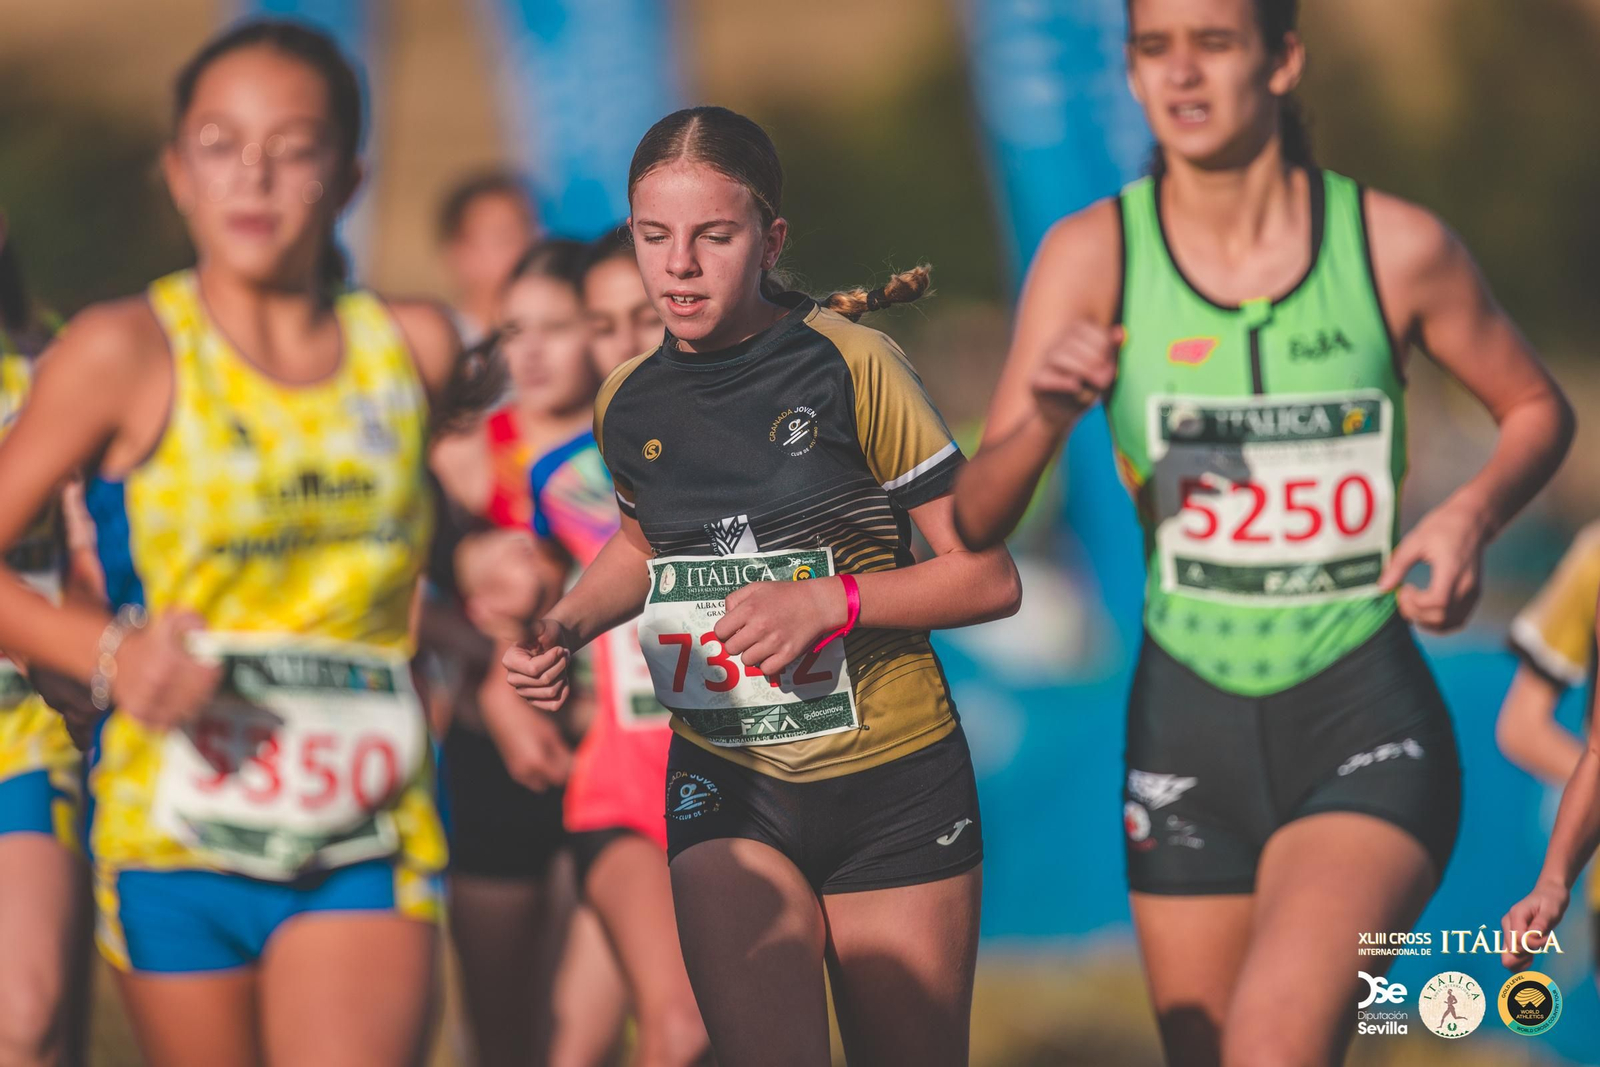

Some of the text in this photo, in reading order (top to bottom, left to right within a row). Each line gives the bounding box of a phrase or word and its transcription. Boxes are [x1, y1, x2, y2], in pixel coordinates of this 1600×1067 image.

[769, 406, 817, 442] GRANADA JOVEN
[1178, 474, 1376, 544] 5250
[687, 561, 777, 587] ITÁLICA
[695, 602, 717, 610] ALBA
[706, 609, 727, 617] GRAN
[811, 705, 844, 719] docunova
[773, 730, 808, 741] ATLETISMO
[193, 717, 399, 810] 5350
[679, 813, 692, 821] CLUB
